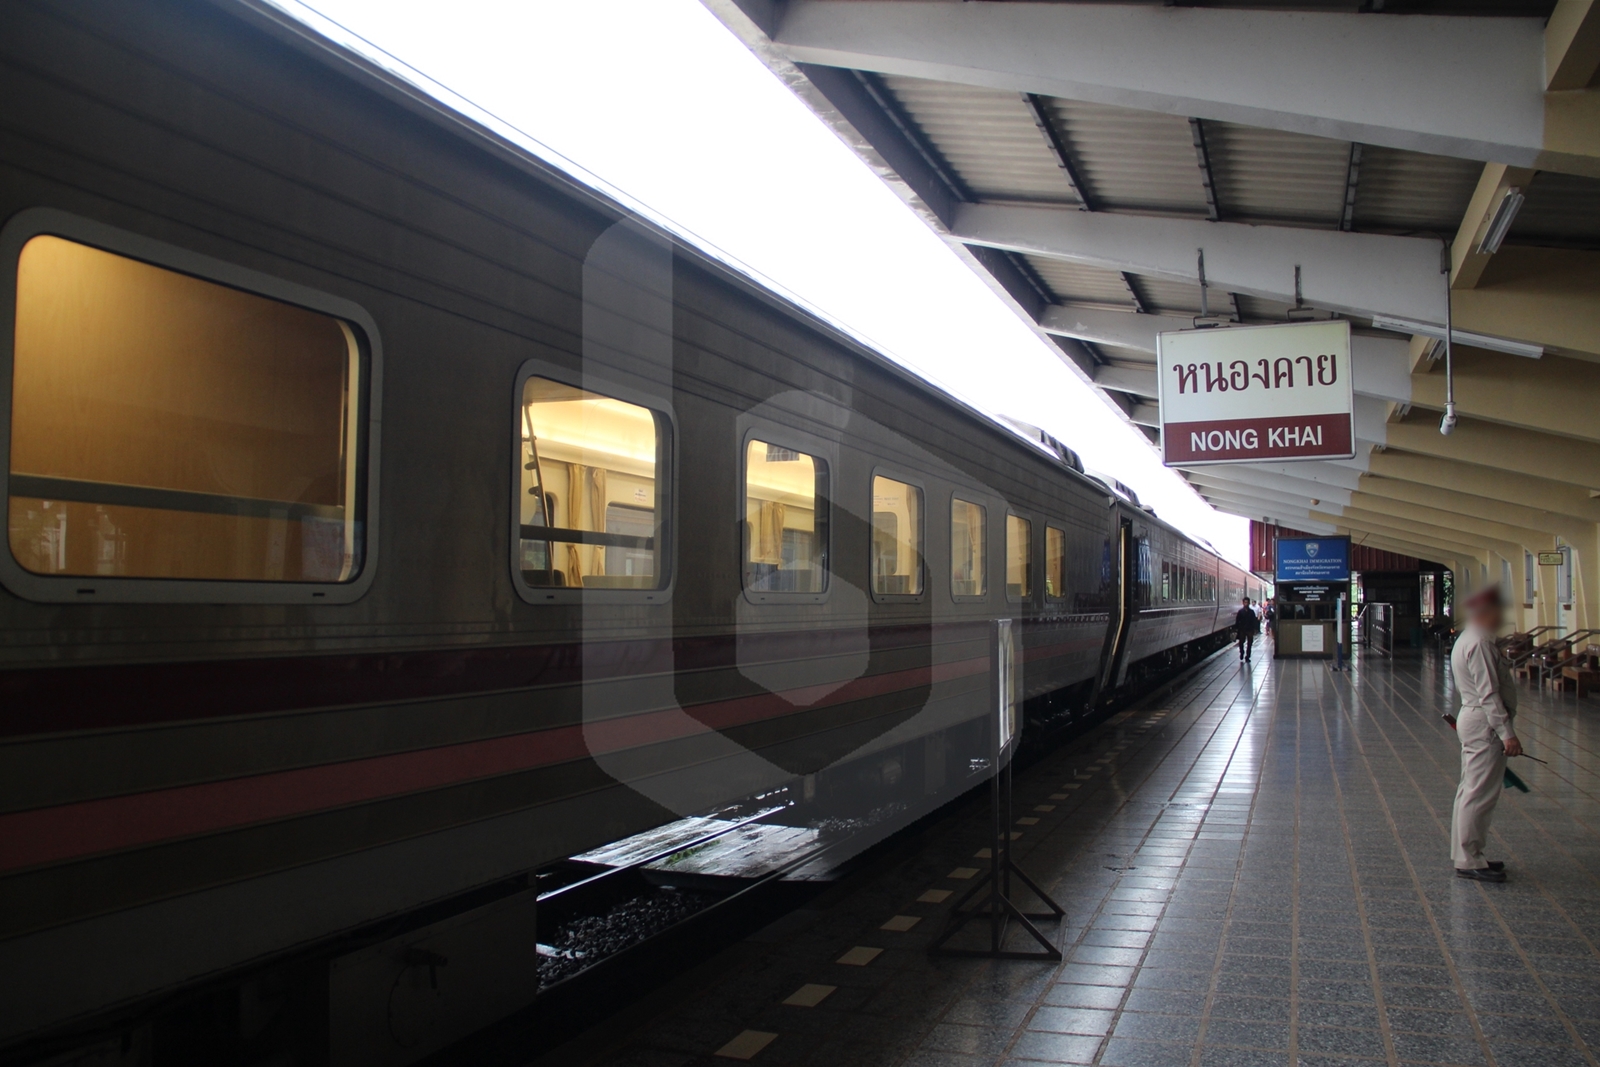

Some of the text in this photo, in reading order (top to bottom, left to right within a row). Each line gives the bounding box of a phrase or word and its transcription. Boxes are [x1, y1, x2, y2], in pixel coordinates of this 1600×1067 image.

[1173, 354, 1337, 394] หนองคาย
[1191, 425, 1323, 451] NONG KHAI
